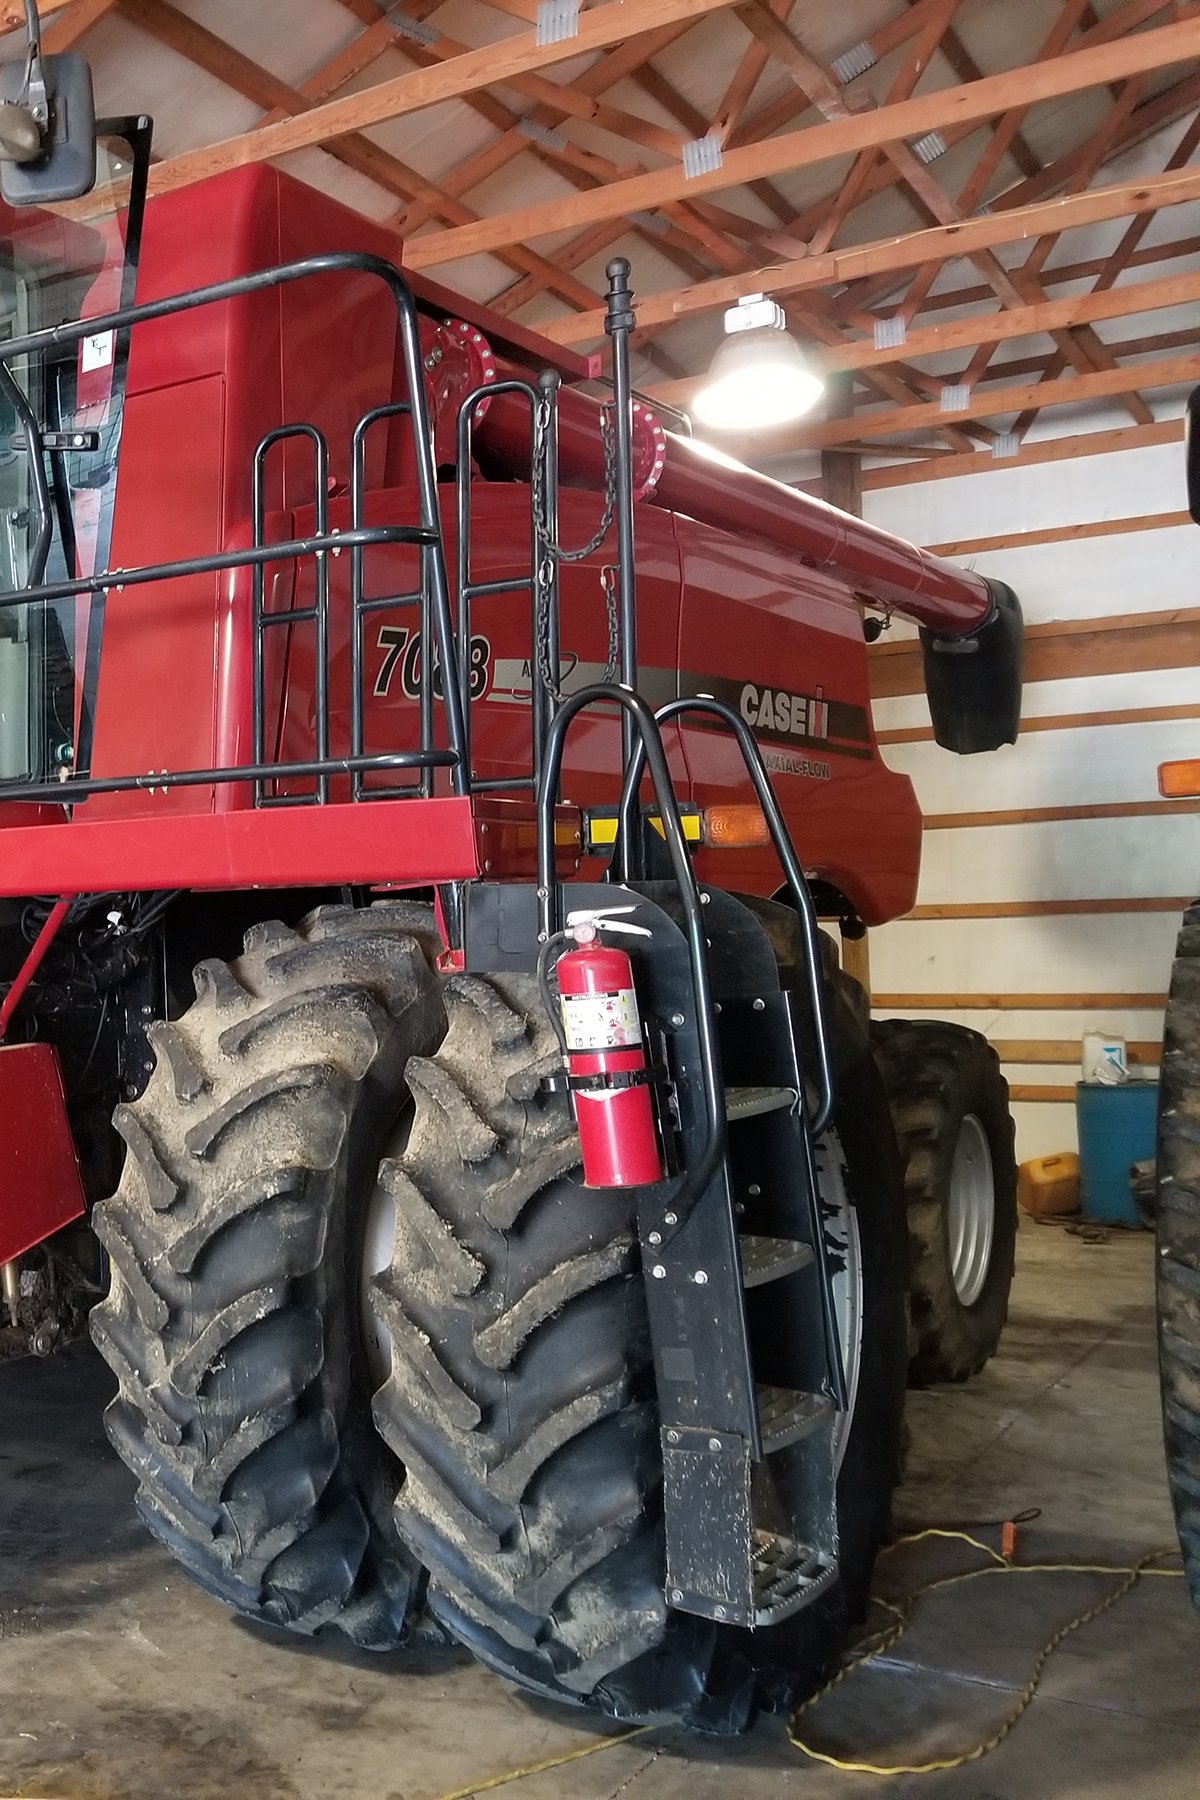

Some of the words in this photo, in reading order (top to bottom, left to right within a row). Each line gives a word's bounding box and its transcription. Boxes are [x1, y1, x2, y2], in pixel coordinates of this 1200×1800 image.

[373, 625, 490, 702] 708
[741, 684, 807, 735] CASE
[764, 752, 831, 780] AXIAL-FLOW
